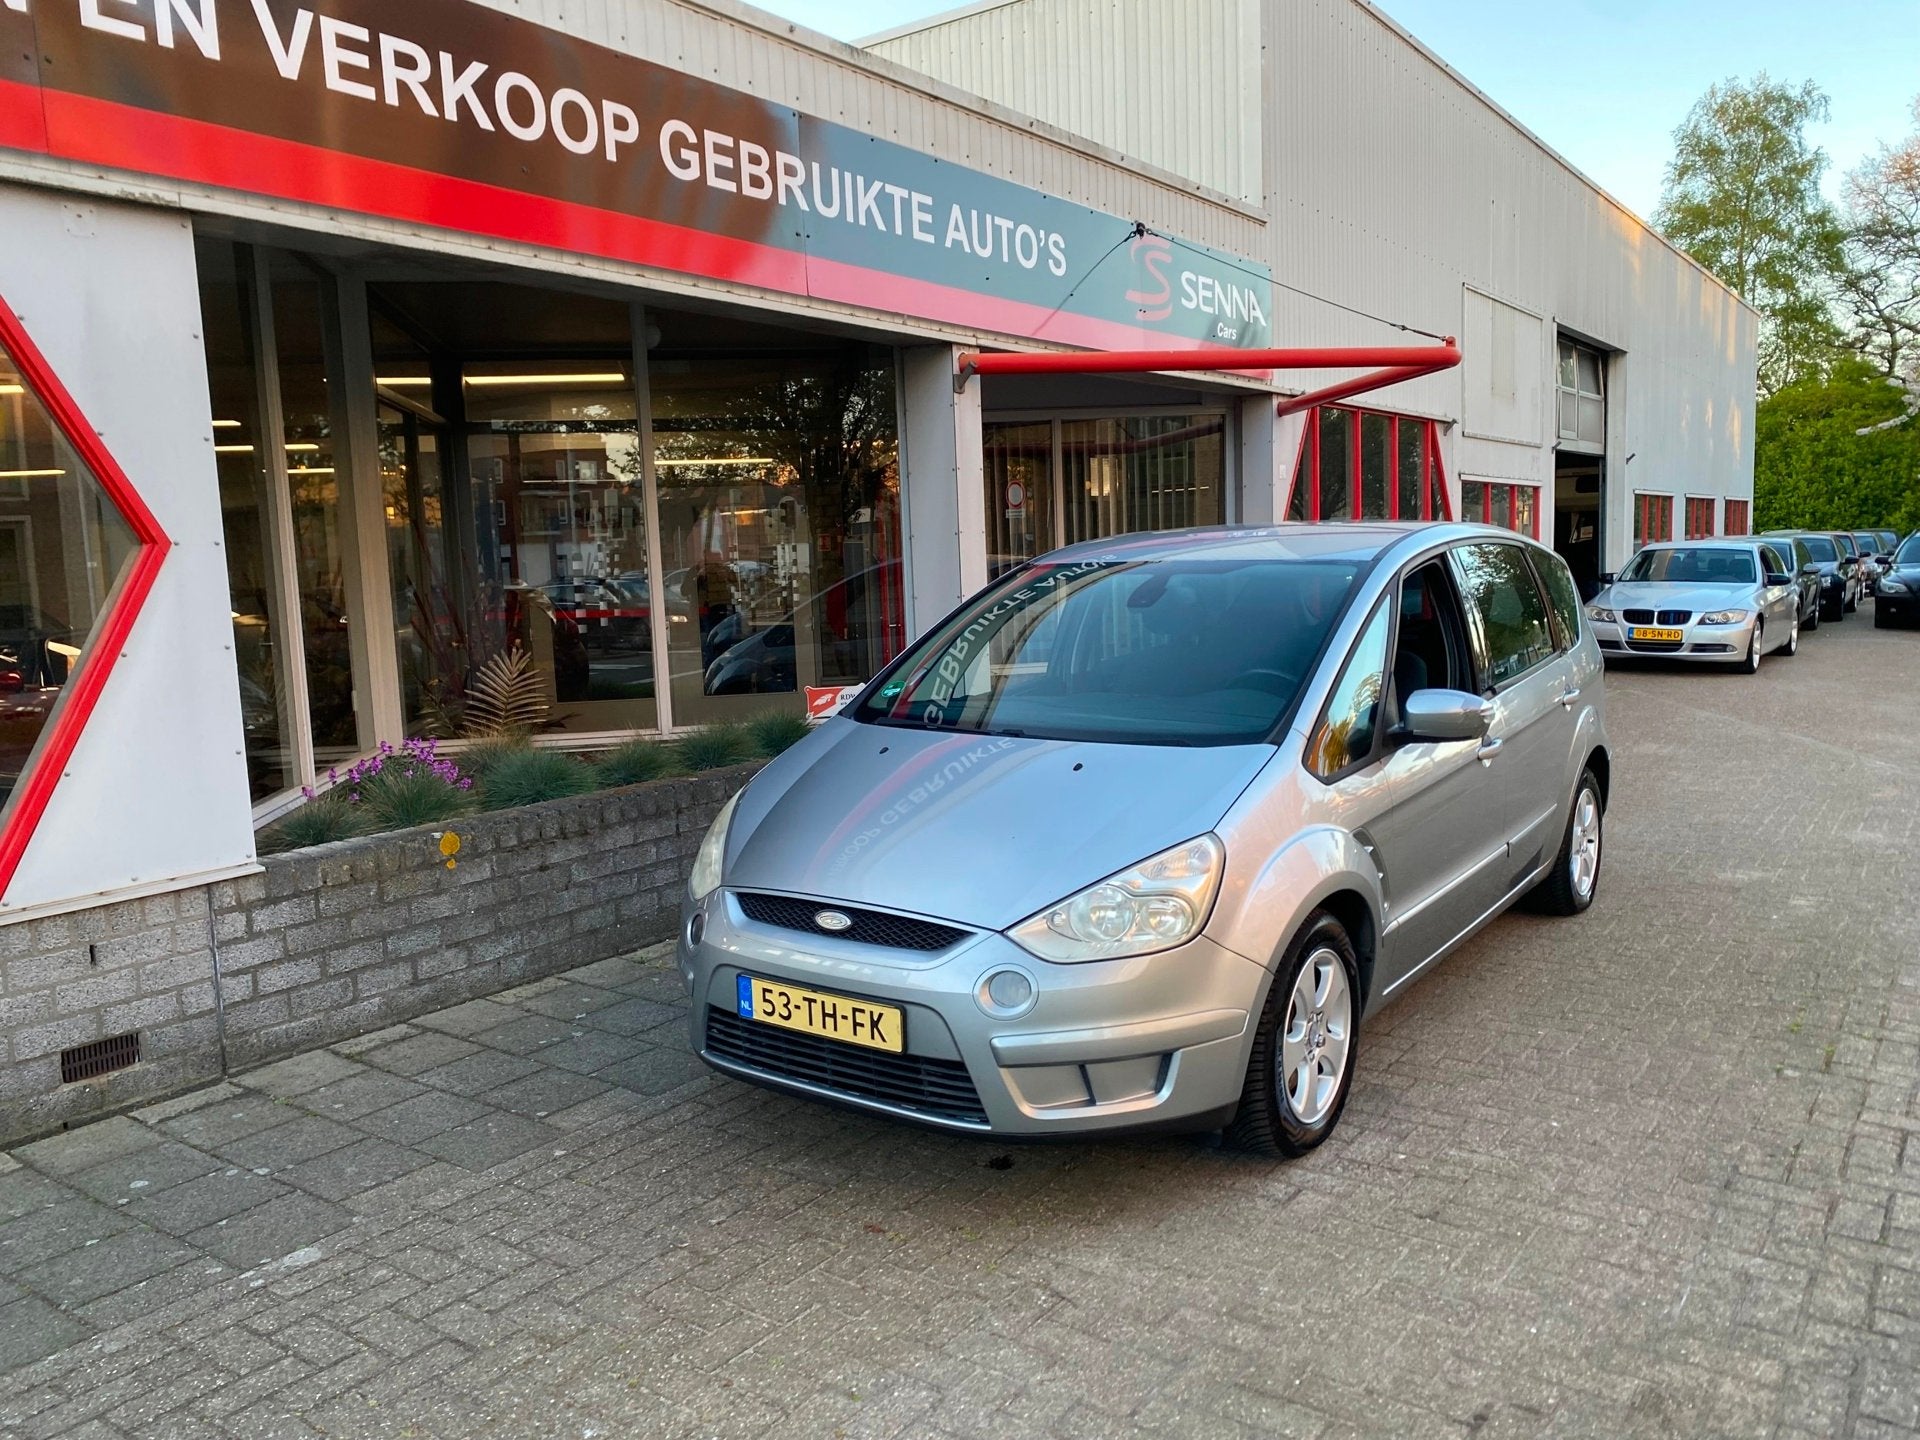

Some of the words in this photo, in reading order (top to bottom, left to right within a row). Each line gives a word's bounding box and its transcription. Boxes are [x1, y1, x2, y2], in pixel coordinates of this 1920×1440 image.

[249, 0, 639, 163] VERKOOP
[659, 119, 935, 245] GEBRUIKTE
[944, 203, 1067, 276] AUTO'S
[1180, 270, 1267, 327] SENNA
[1217, 322, 1237, 340] Cars
[741, 1000, 752, 1011] NL
[762, 987, 887, 1043] 53-TH-FK
